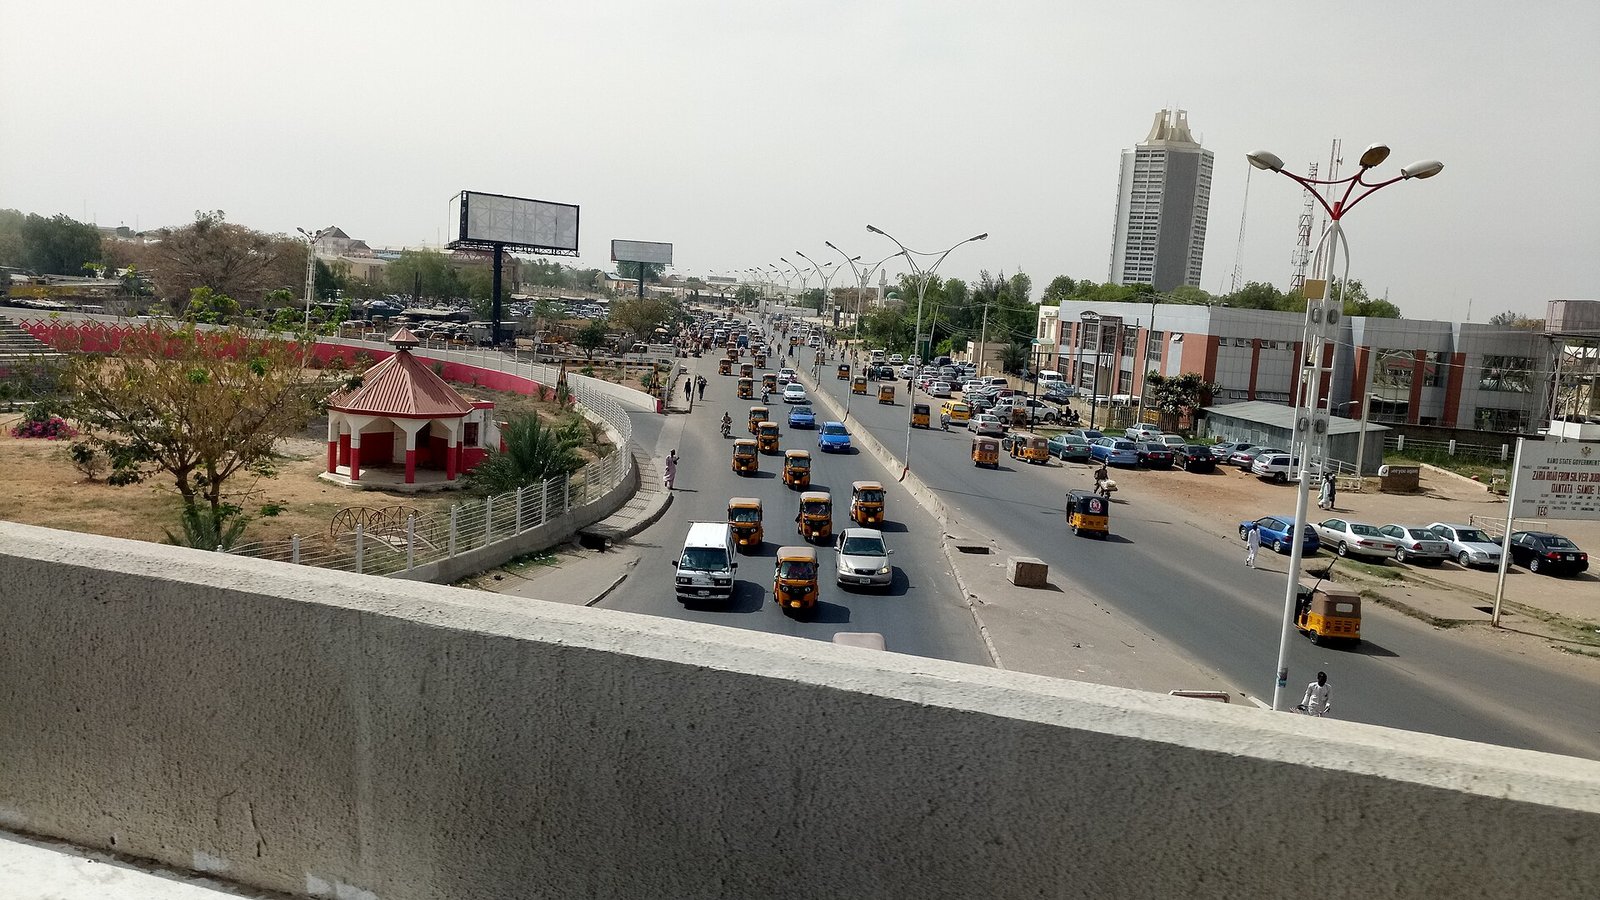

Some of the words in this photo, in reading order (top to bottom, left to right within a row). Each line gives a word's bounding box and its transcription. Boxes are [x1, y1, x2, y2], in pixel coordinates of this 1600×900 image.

[1532, 470, 1546, 480] ZARIA
[1546, 471, 1558, 481] ROAD
[1558, 471, 1570, 481] FROM
[1570, 472, 1588, 482] SILVER
[1537, 506, 1548, 516] TEC
